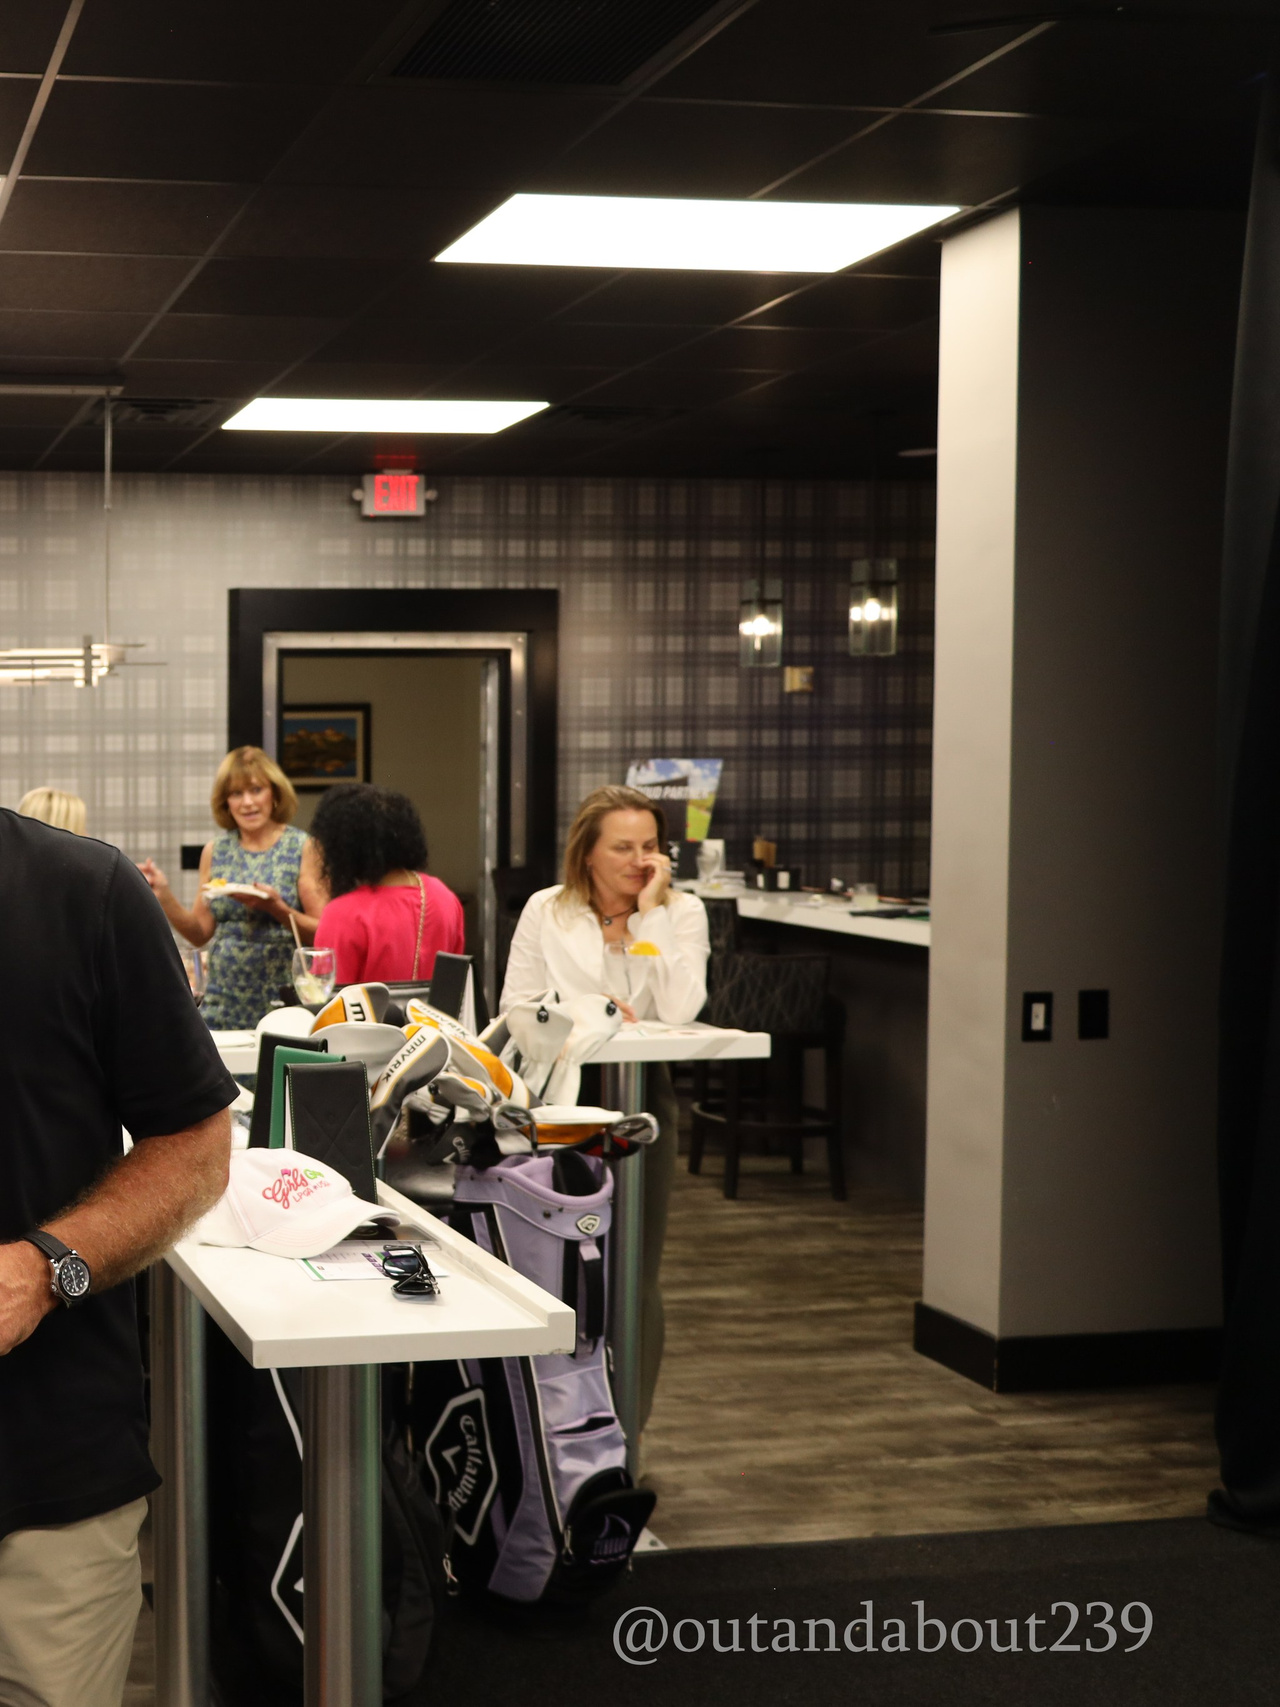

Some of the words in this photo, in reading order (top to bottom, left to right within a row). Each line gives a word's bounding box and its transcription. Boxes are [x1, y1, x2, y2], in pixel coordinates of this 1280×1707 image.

[374, 474, 420, 512] EXIT
[381, 1034, 427, 1083] MAVRIK
[447, 1414, 483, 1512] Callaway
